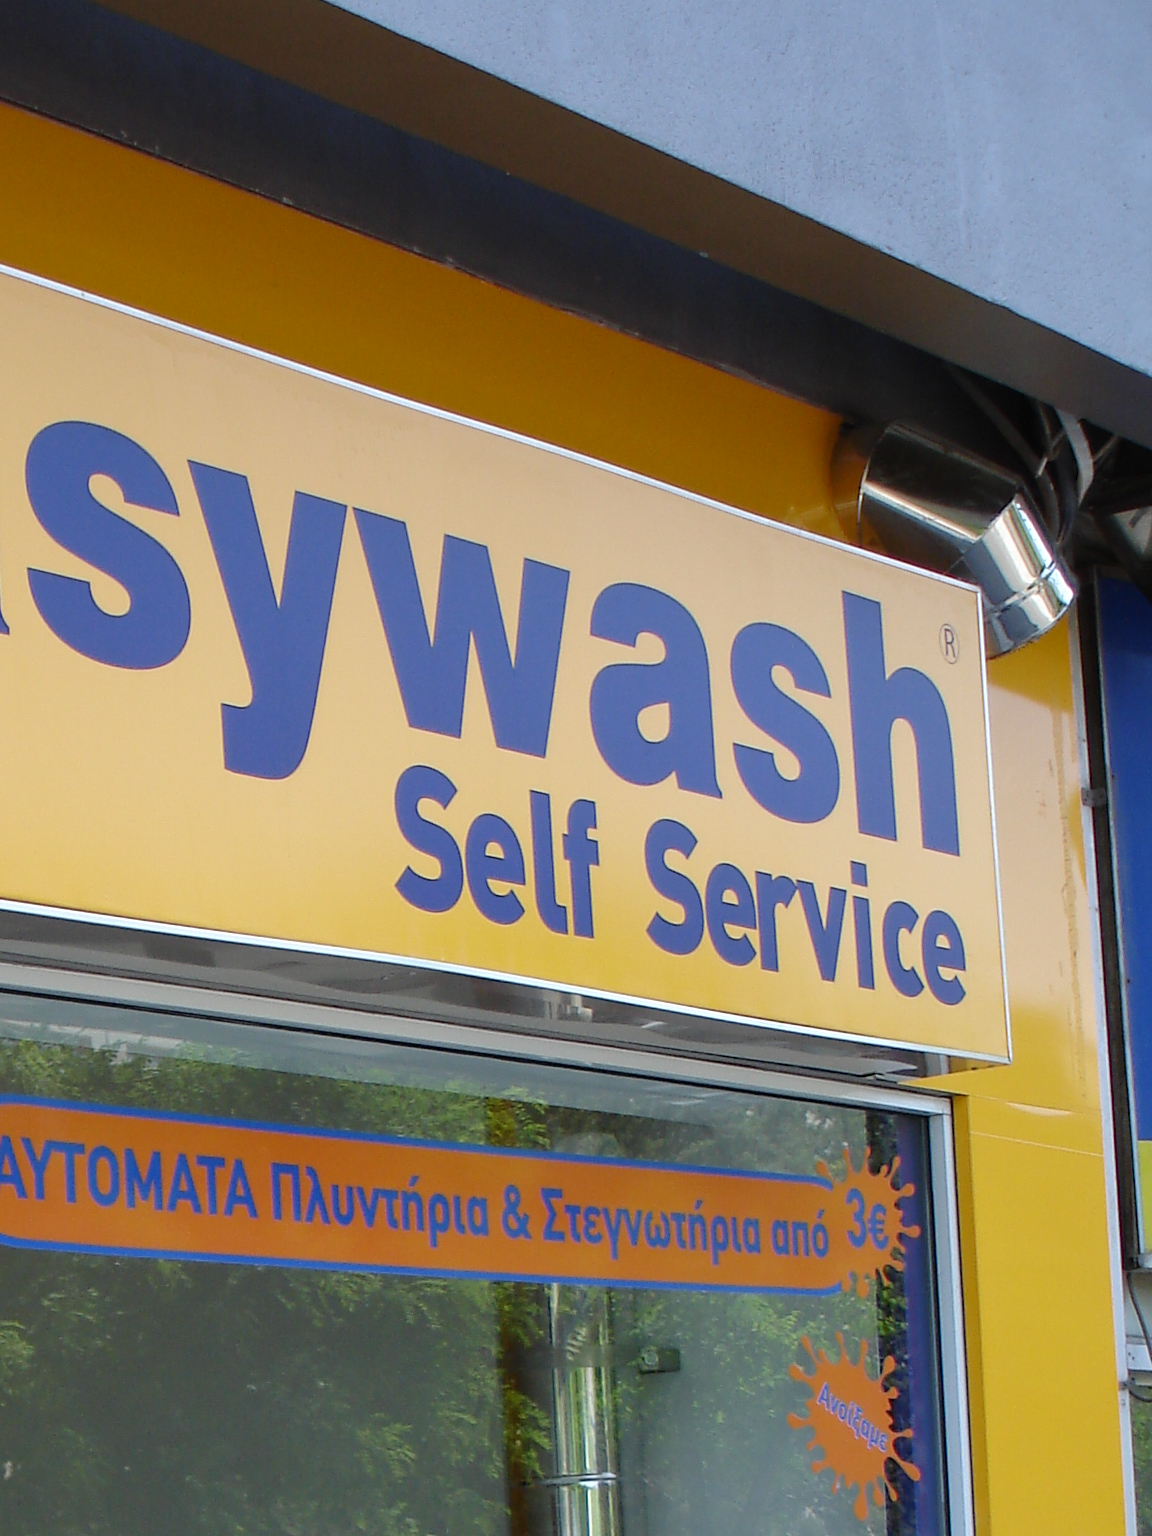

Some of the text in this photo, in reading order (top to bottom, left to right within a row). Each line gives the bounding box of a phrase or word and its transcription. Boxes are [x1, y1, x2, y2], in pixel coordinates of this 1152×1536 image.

[394, 764, 967, 1006] Self Service
[270, 1162, 489, 1248] Πλυντήρια
[500, 1184, 531, 1240] &
[541, 1188, 762, 1265] Στεγνωτήρια
[771, 1208, 829, 1258] από
[844, 1188, 890, 1250] 3€
[816, 1381, 889, 1453] Ανοίξαμε
